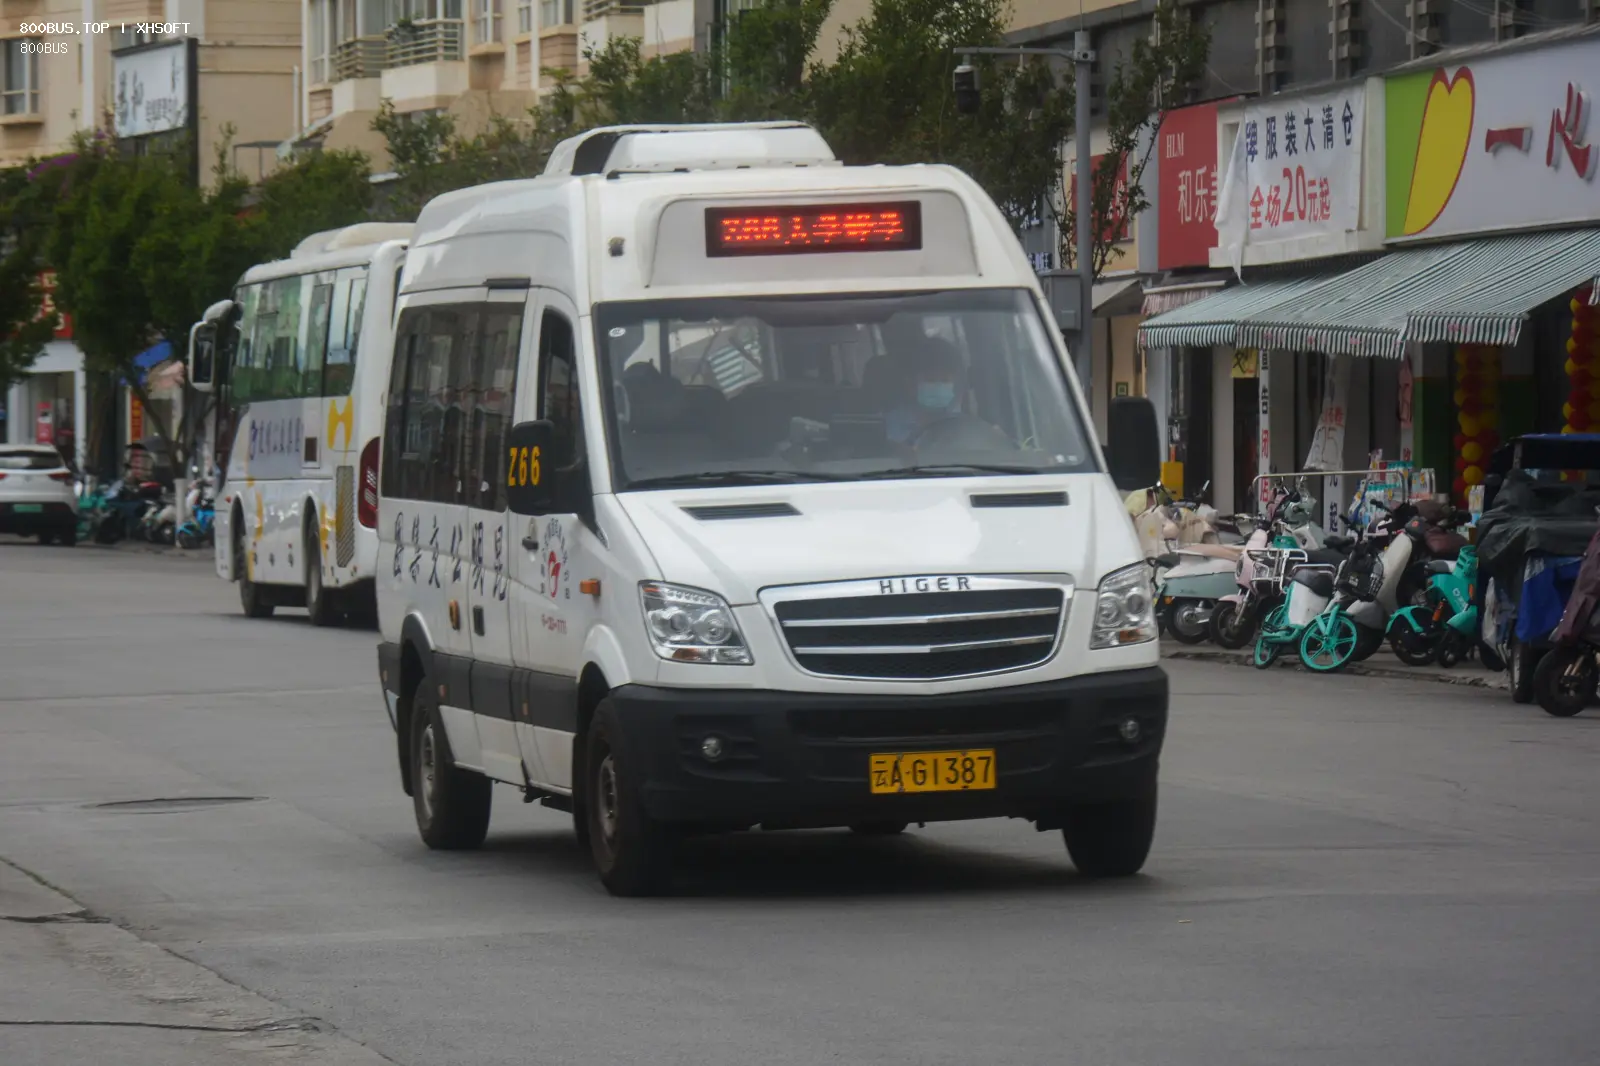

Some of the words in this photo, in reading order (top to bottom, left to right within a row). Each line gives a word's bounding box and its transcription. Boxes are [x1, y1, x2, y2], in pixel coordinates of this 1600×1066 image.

[1249, 164, 1331, 229] 全场20元起
[879, 576, 971, 595] HIGER
